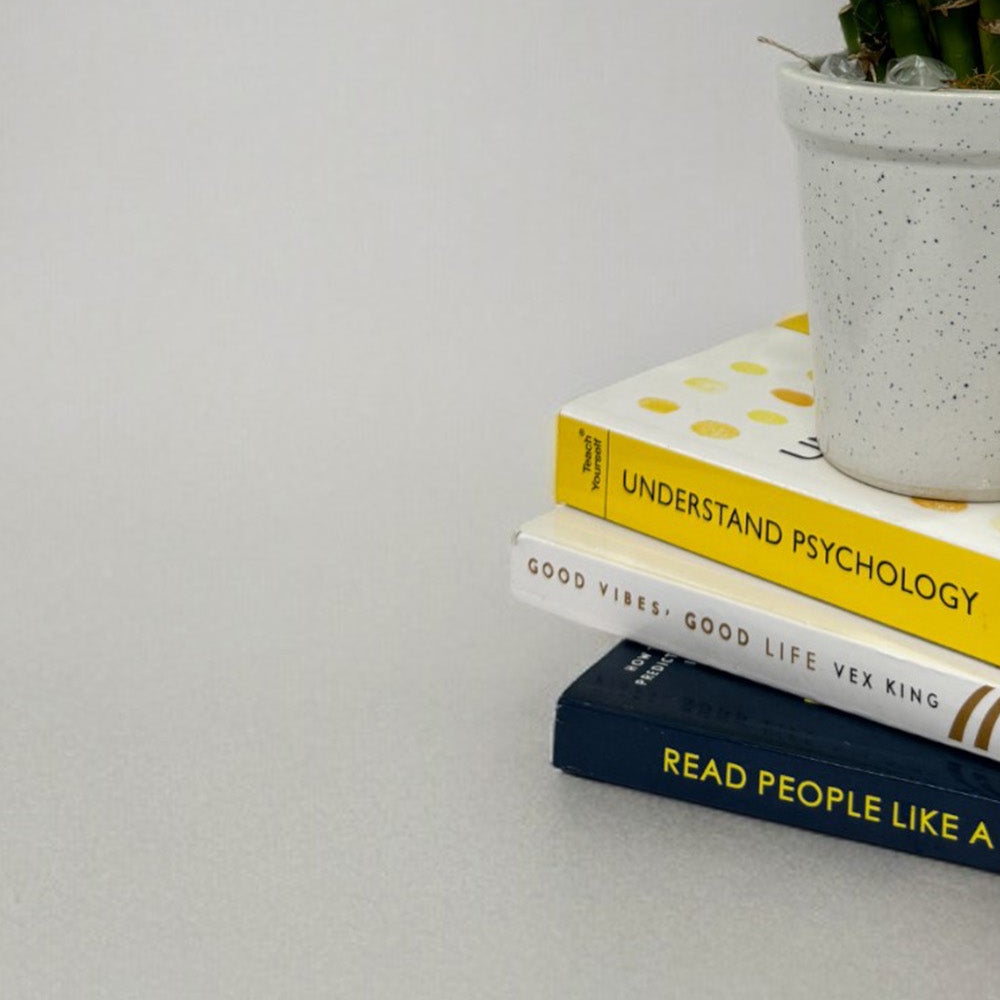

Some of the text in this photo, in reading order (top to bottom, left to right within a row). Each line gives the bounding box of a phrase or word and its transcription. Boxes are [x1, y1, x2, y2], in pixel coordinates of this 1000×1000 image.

[591, 438, 602, 490] Yourself
[622, 469, 783, 546] UNDERSTAND
[793, 529, 979, 615] PSYCHOLOGY
[527, 557, 940, 709] GOOD VIBES, GOOD LIFE VEX KING
[624, 652, 652, 672] HOW
[662, 747, 747, 790] READ
[758, 770, 881, 824] PEOPLE
[892, 803, 959, 841] LIKE
[969, 821, 995, 849] A
